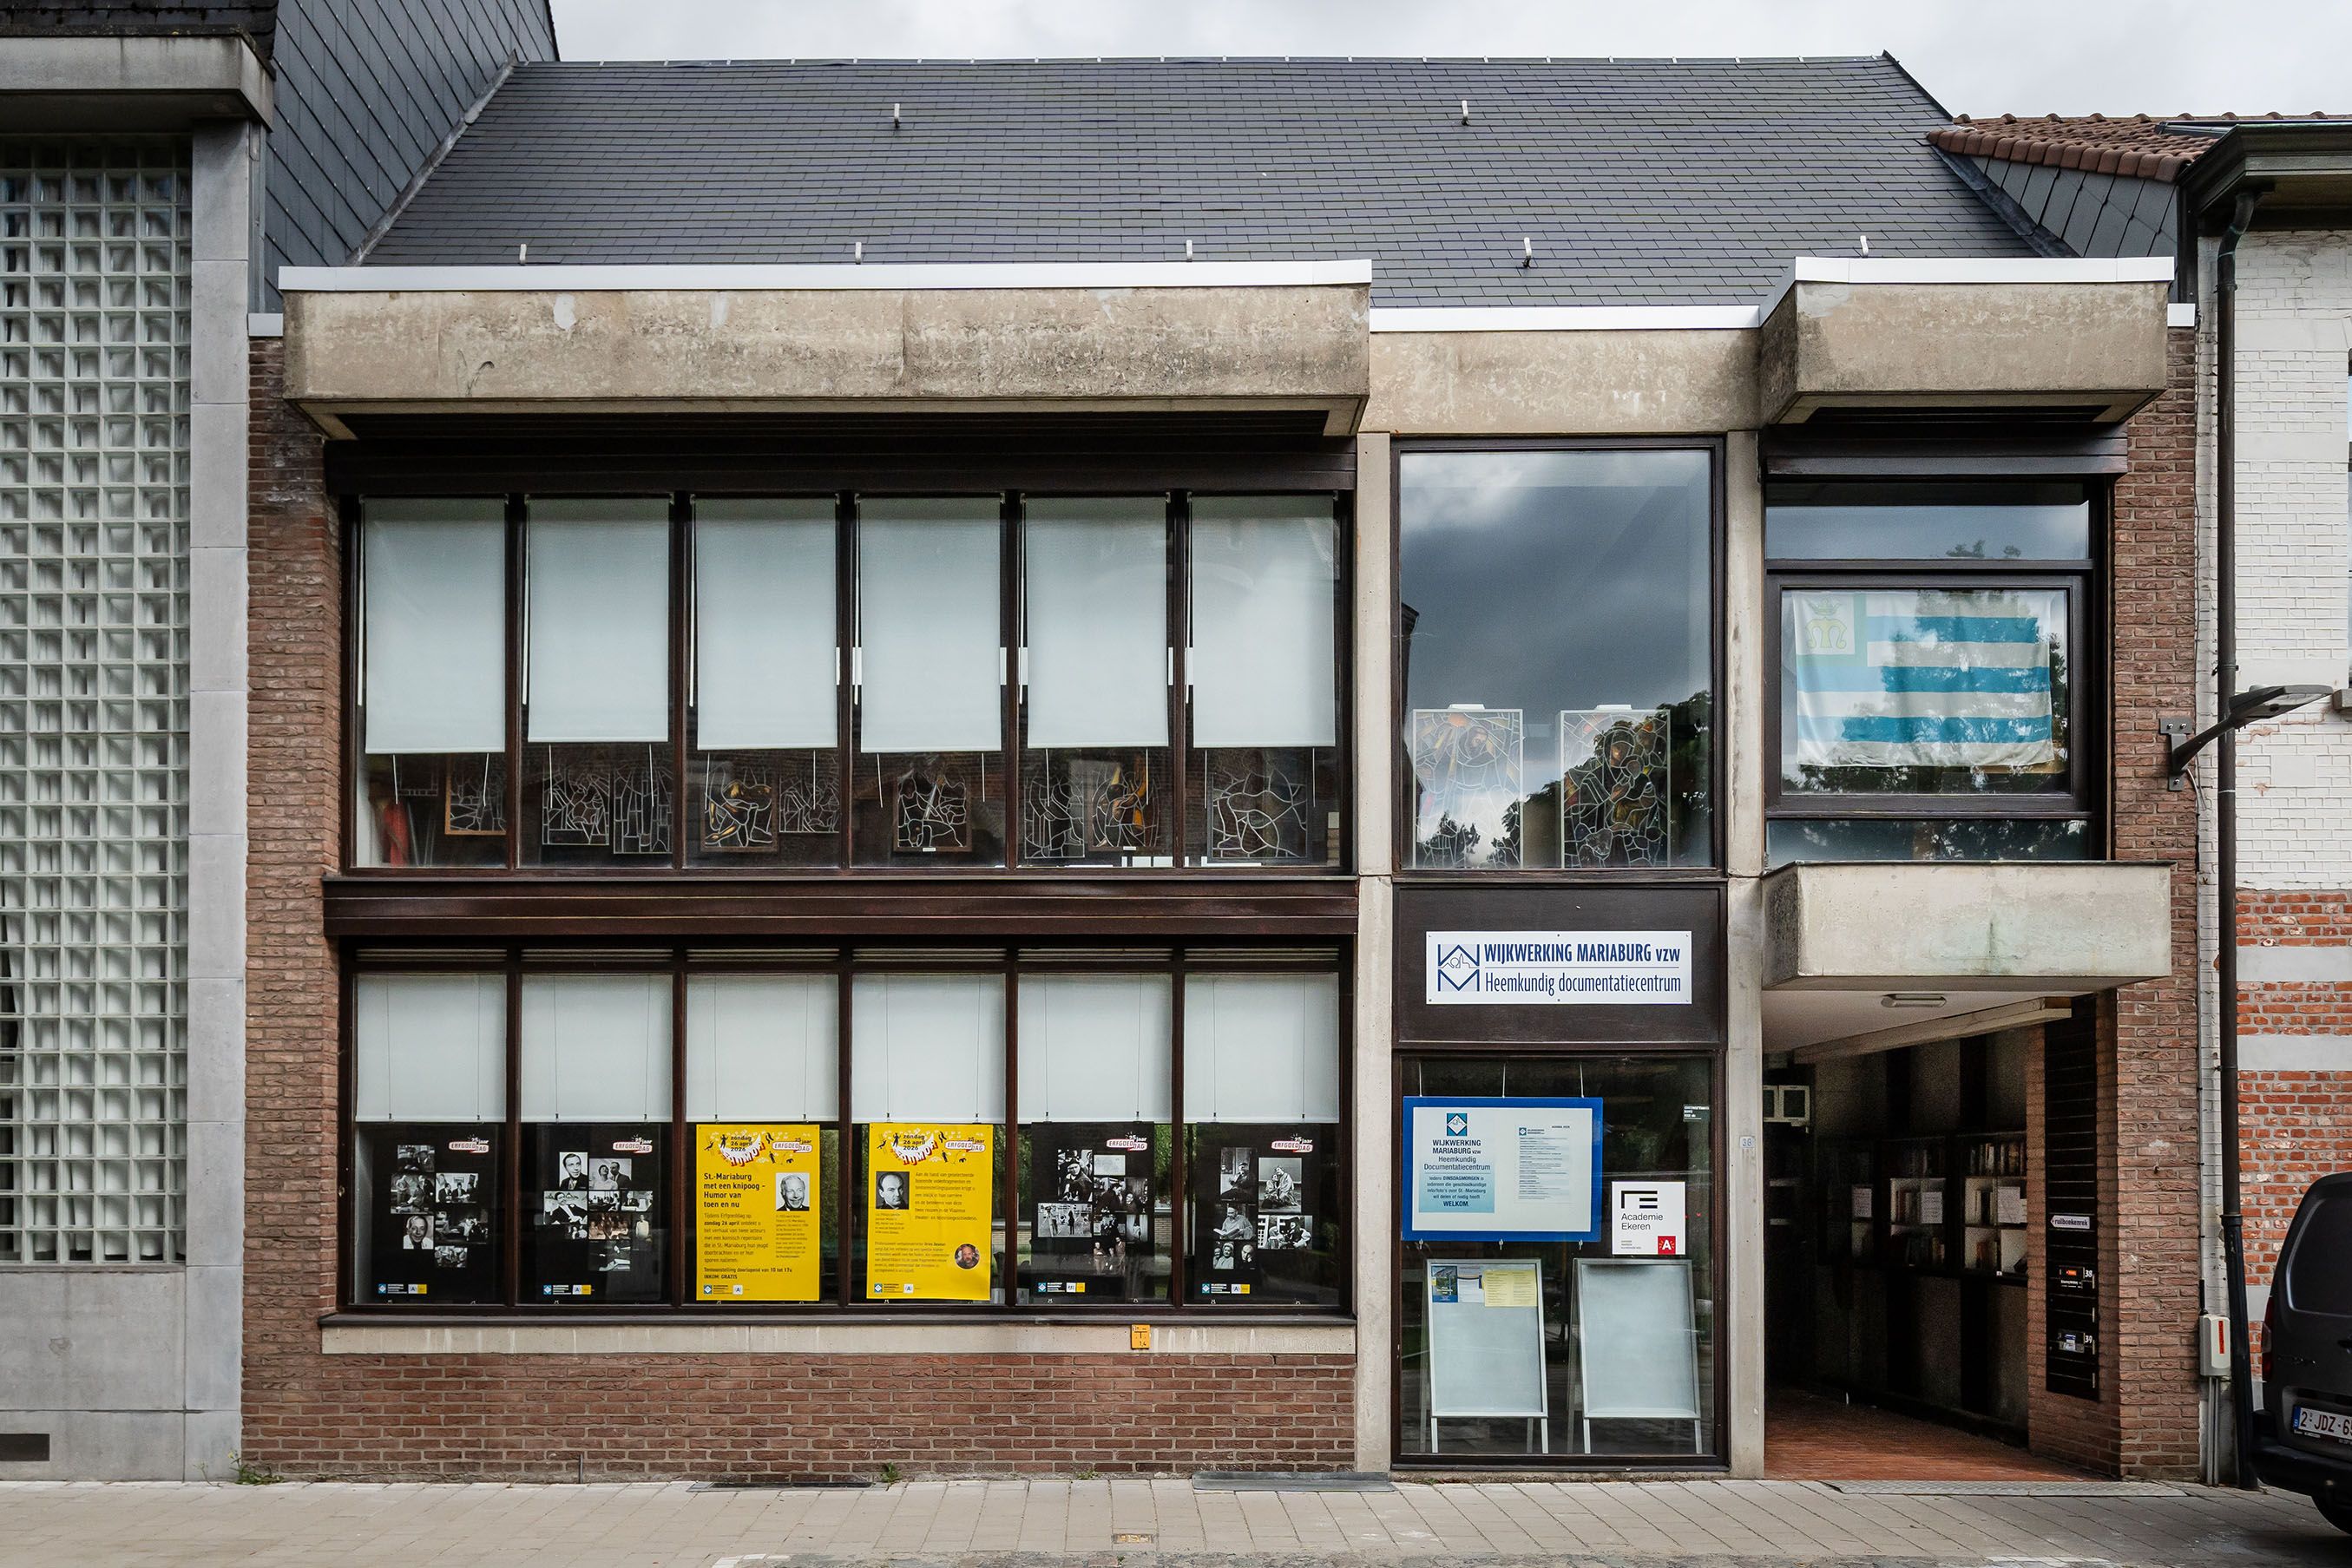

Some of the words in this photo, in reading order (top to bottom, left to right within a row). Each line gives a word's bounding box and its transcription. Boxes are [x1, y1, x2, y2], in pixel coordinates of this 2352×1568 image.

[1484, 943, 1572, 964] WIJKWERKING
[1577, 943, 1652, 962] MARIABURG
[1485, 972, 1554, 996] Heemkundig
[1559, 972, 1681, 993] documentatiecentrum
[733, 1183, 760, 1191] knipoog
[1620, 1212, 1664, 1221] Academie
[1621, 1222, 1652, 1230] Ekeren
